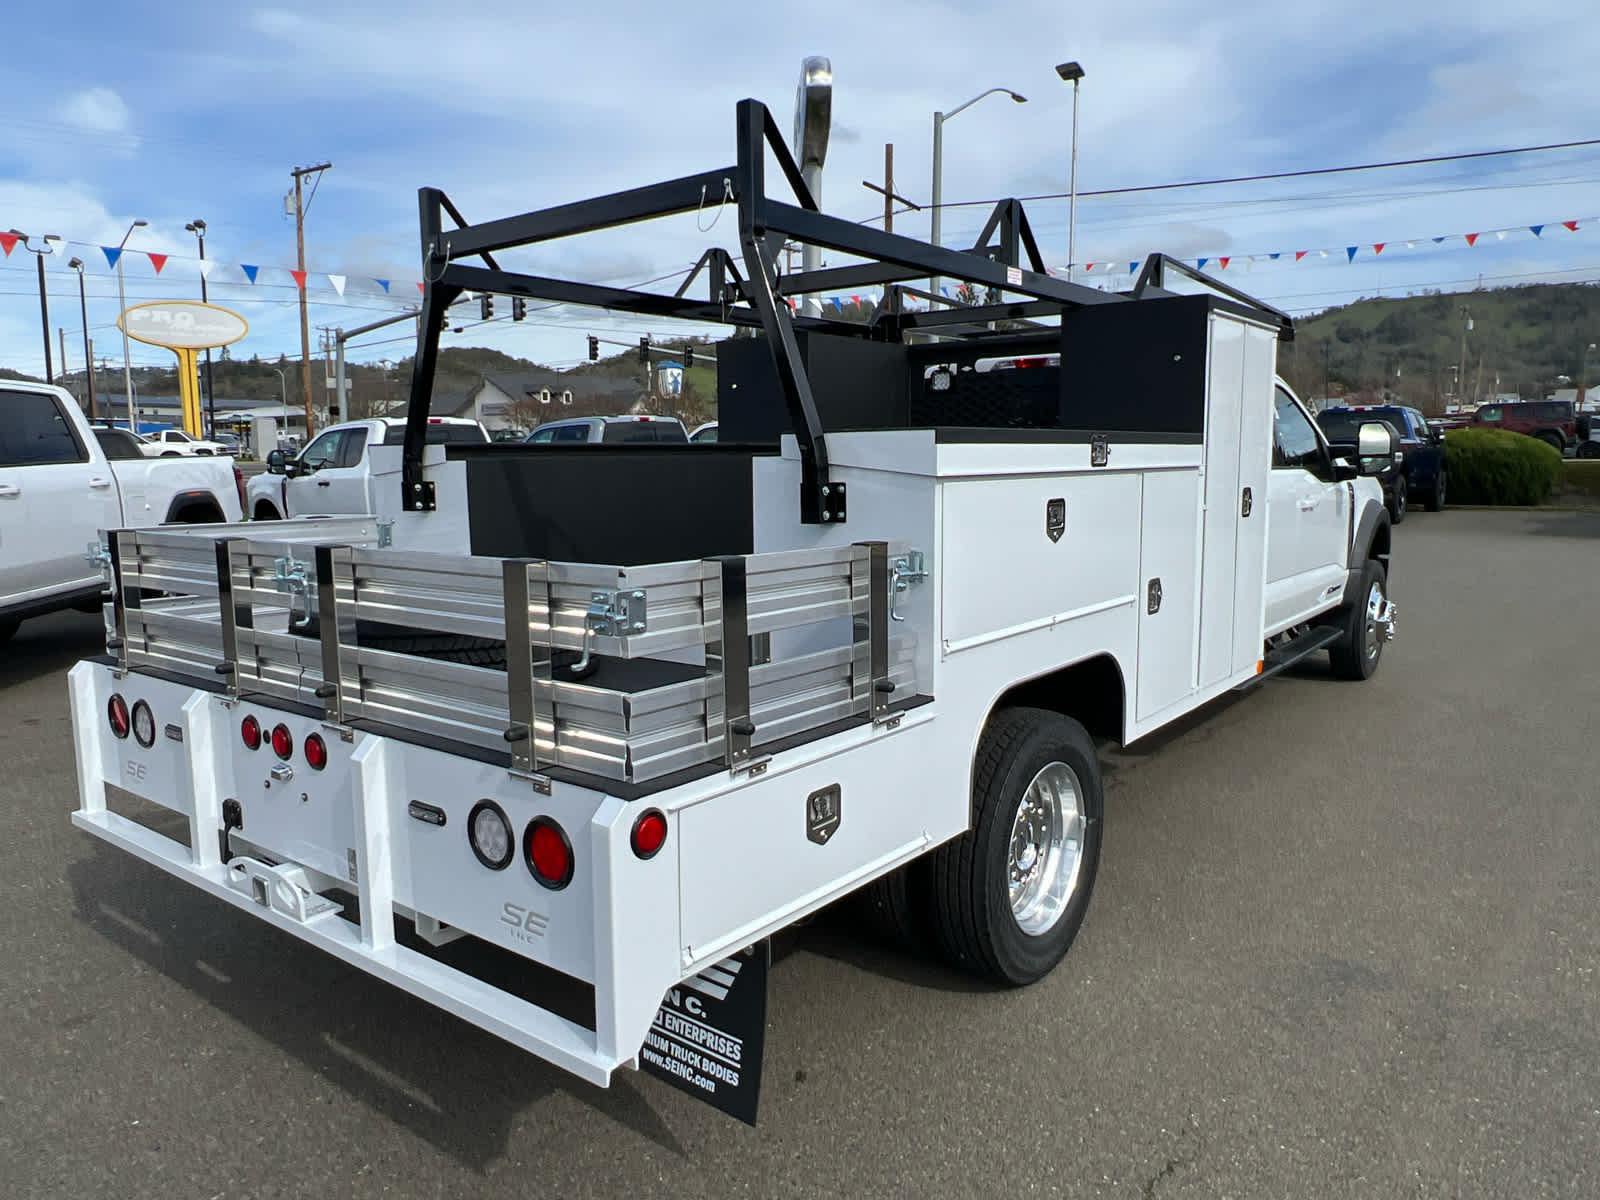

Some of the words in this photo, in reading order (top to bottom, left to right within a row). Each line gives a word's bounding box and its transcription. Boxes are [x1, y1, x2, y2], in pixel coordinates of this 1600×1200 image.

[500, 901, 550, 937] SE
[664, 1013, 742, 1061] ENTERPRISES
[670, 1042, 702, 1069] TRUCK
[701, 1057, 740, 1086] BODIES
